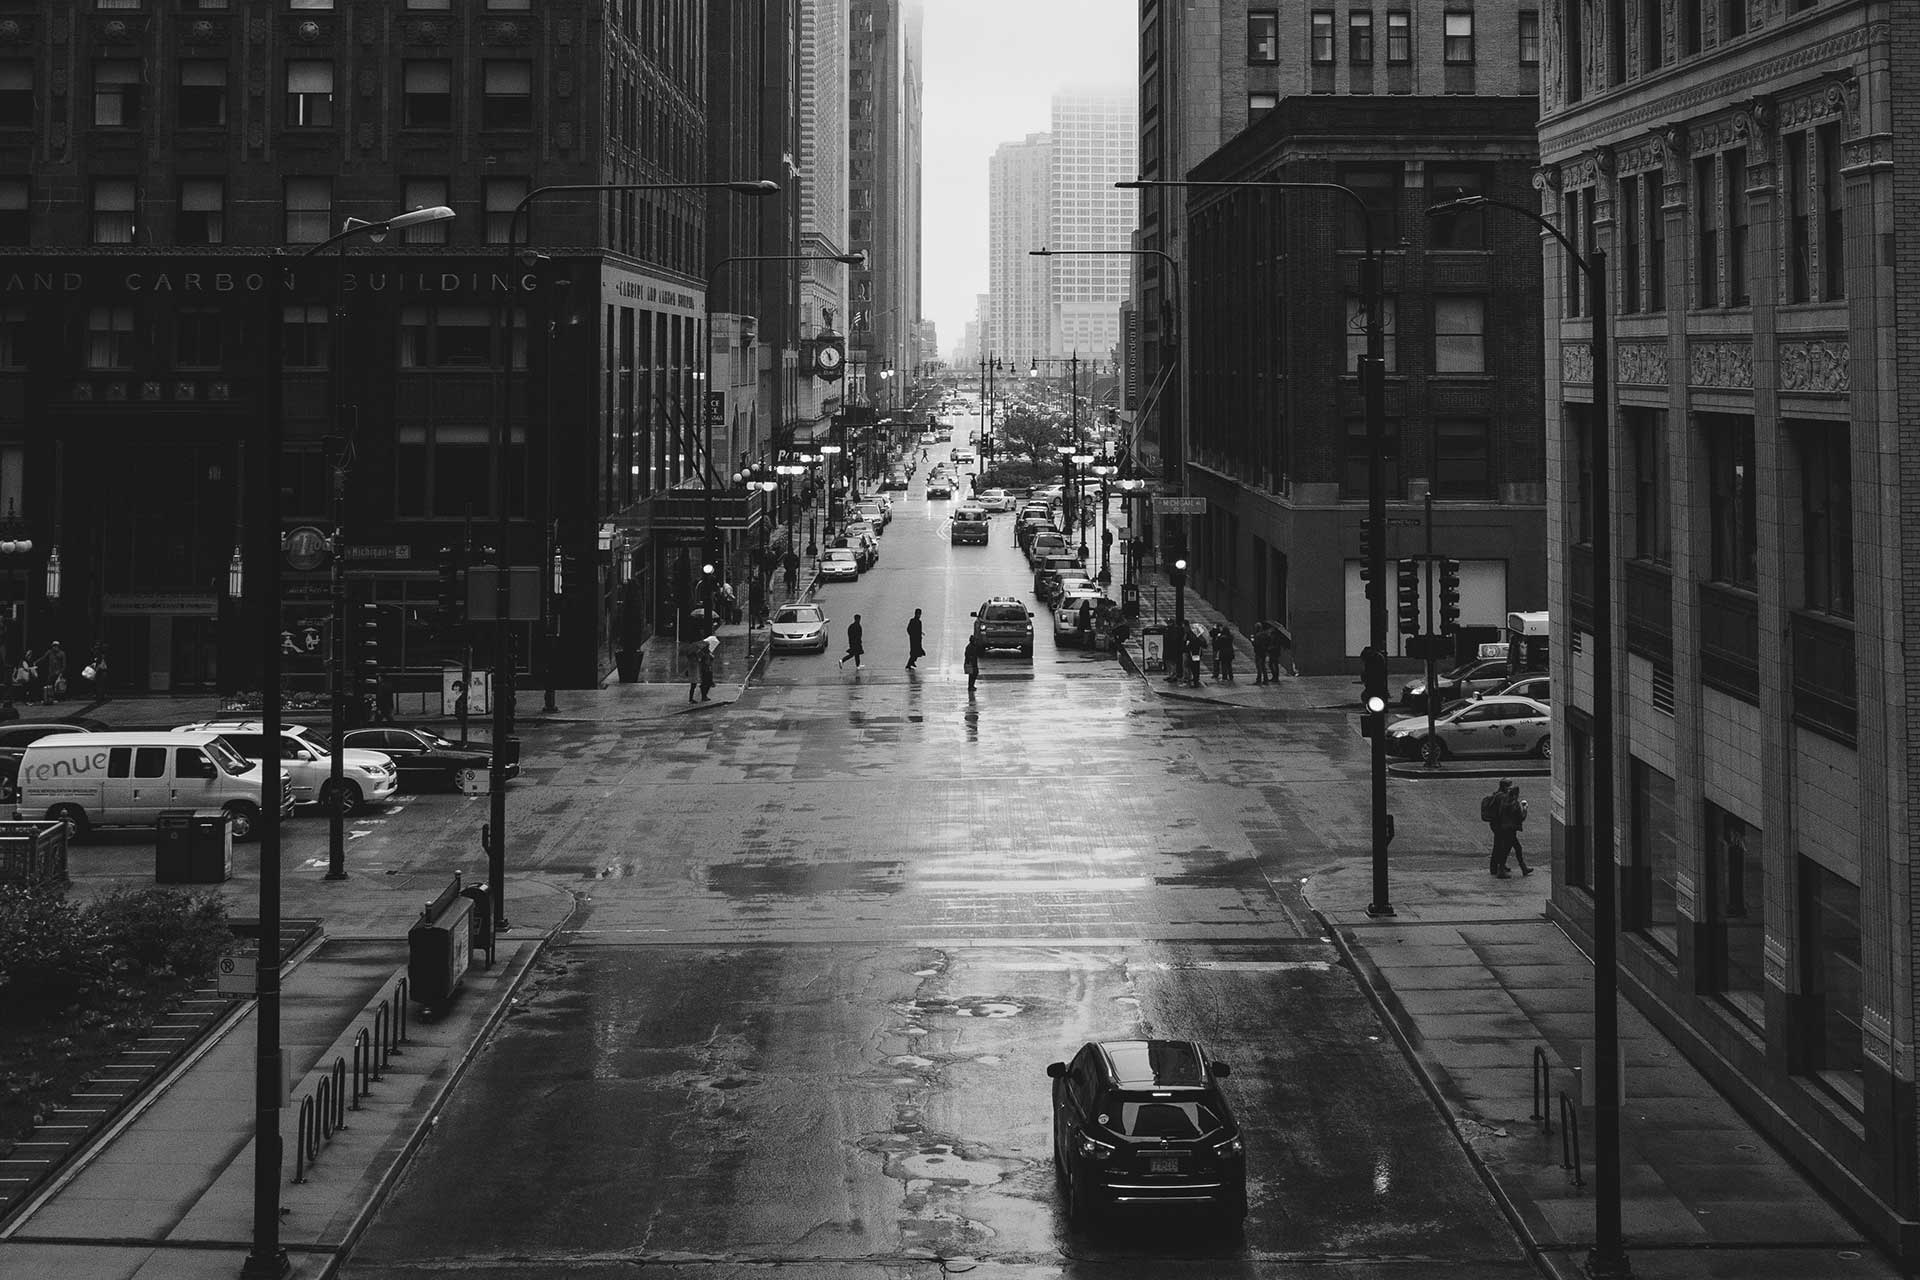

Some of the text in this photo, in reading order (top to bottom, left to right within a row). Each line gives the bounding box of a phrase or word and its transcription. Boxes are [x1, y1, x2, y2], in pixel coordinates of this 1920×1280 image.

[6, 272, 537, 291] AND CARBON BUILDING
[1128, 313, 1137, 397] Hilton Garden Inn
[24, 752, 108, 784] renue
